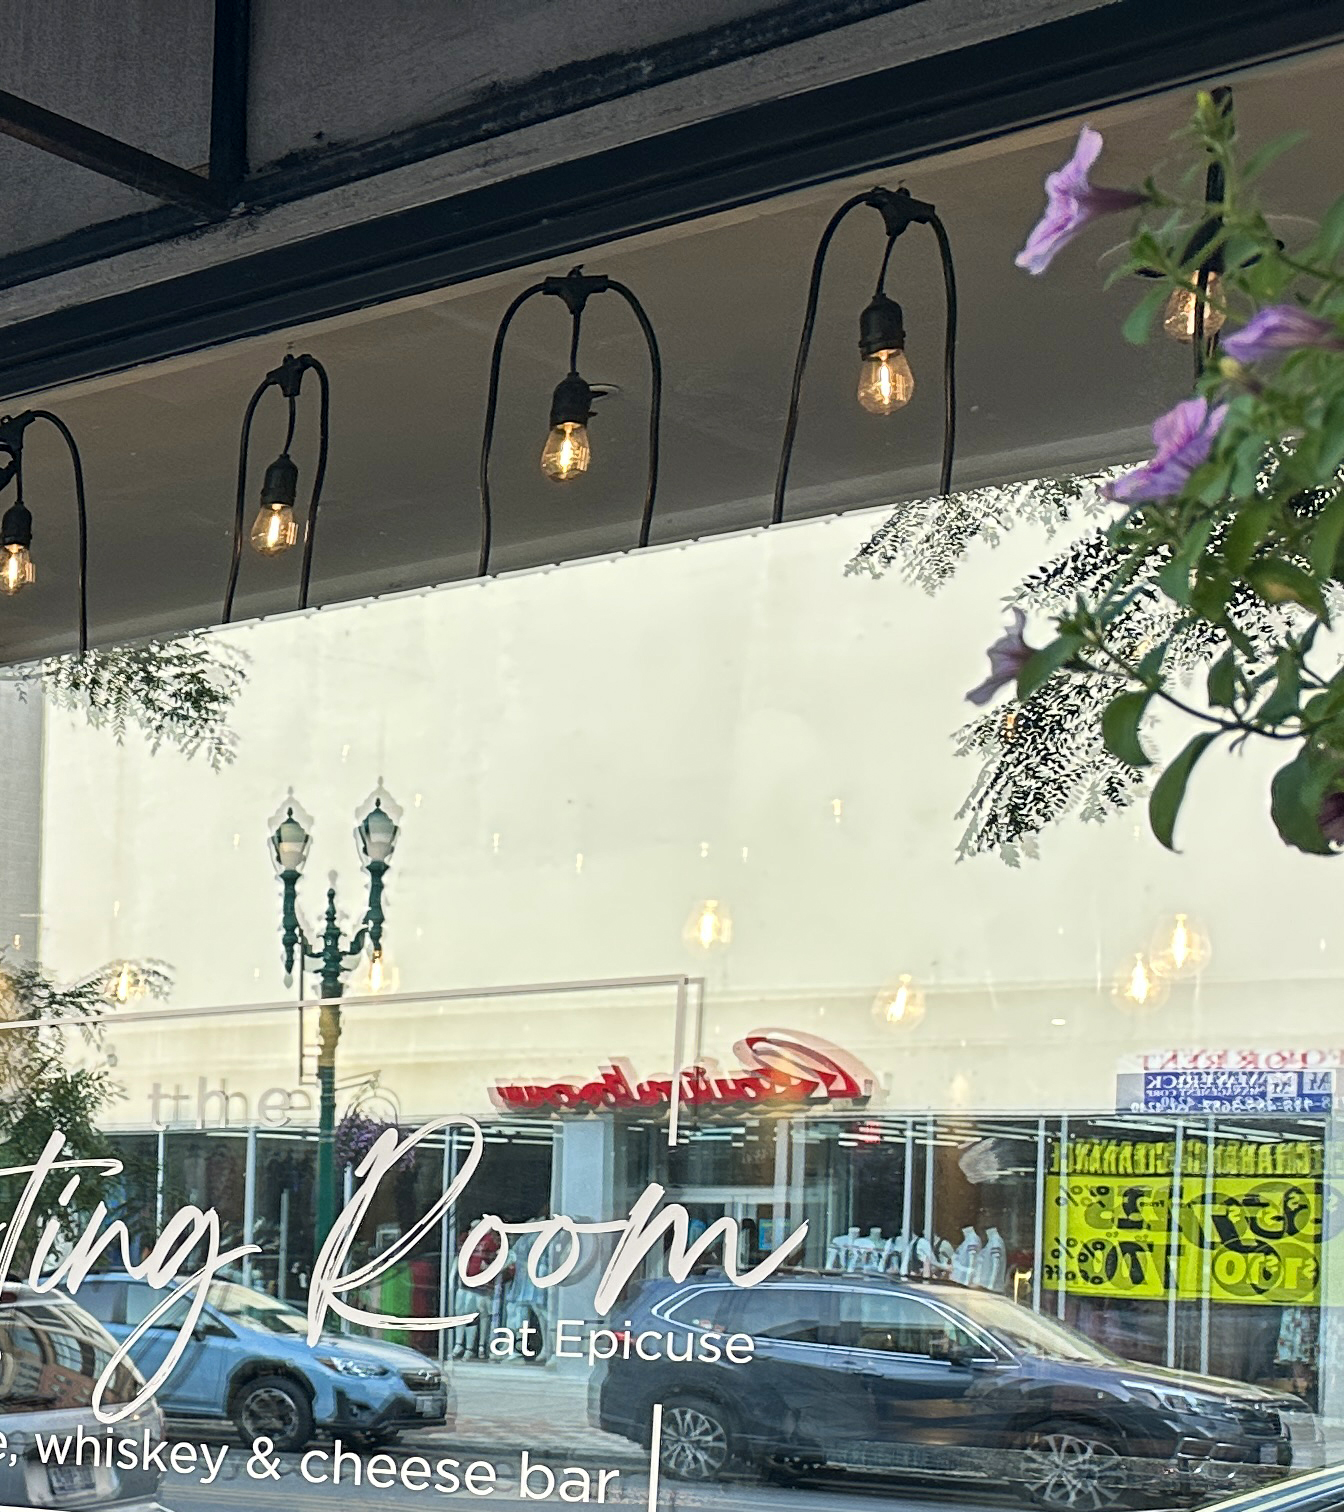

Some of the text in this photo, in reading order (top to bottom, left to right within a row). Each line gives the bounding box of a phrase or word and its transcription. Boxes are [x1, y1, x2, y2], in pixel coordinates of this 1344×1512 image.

[307, 1110, 808, 1352] Room
[490, 1319, 754, 1366] at Epicuse
[34, 1424, 229, 1484] whiskey
[246, 1436, 281, 1480] &
[300, 1439, 496, 1496] cheese
[520, 1456, 620, 1504] bar
